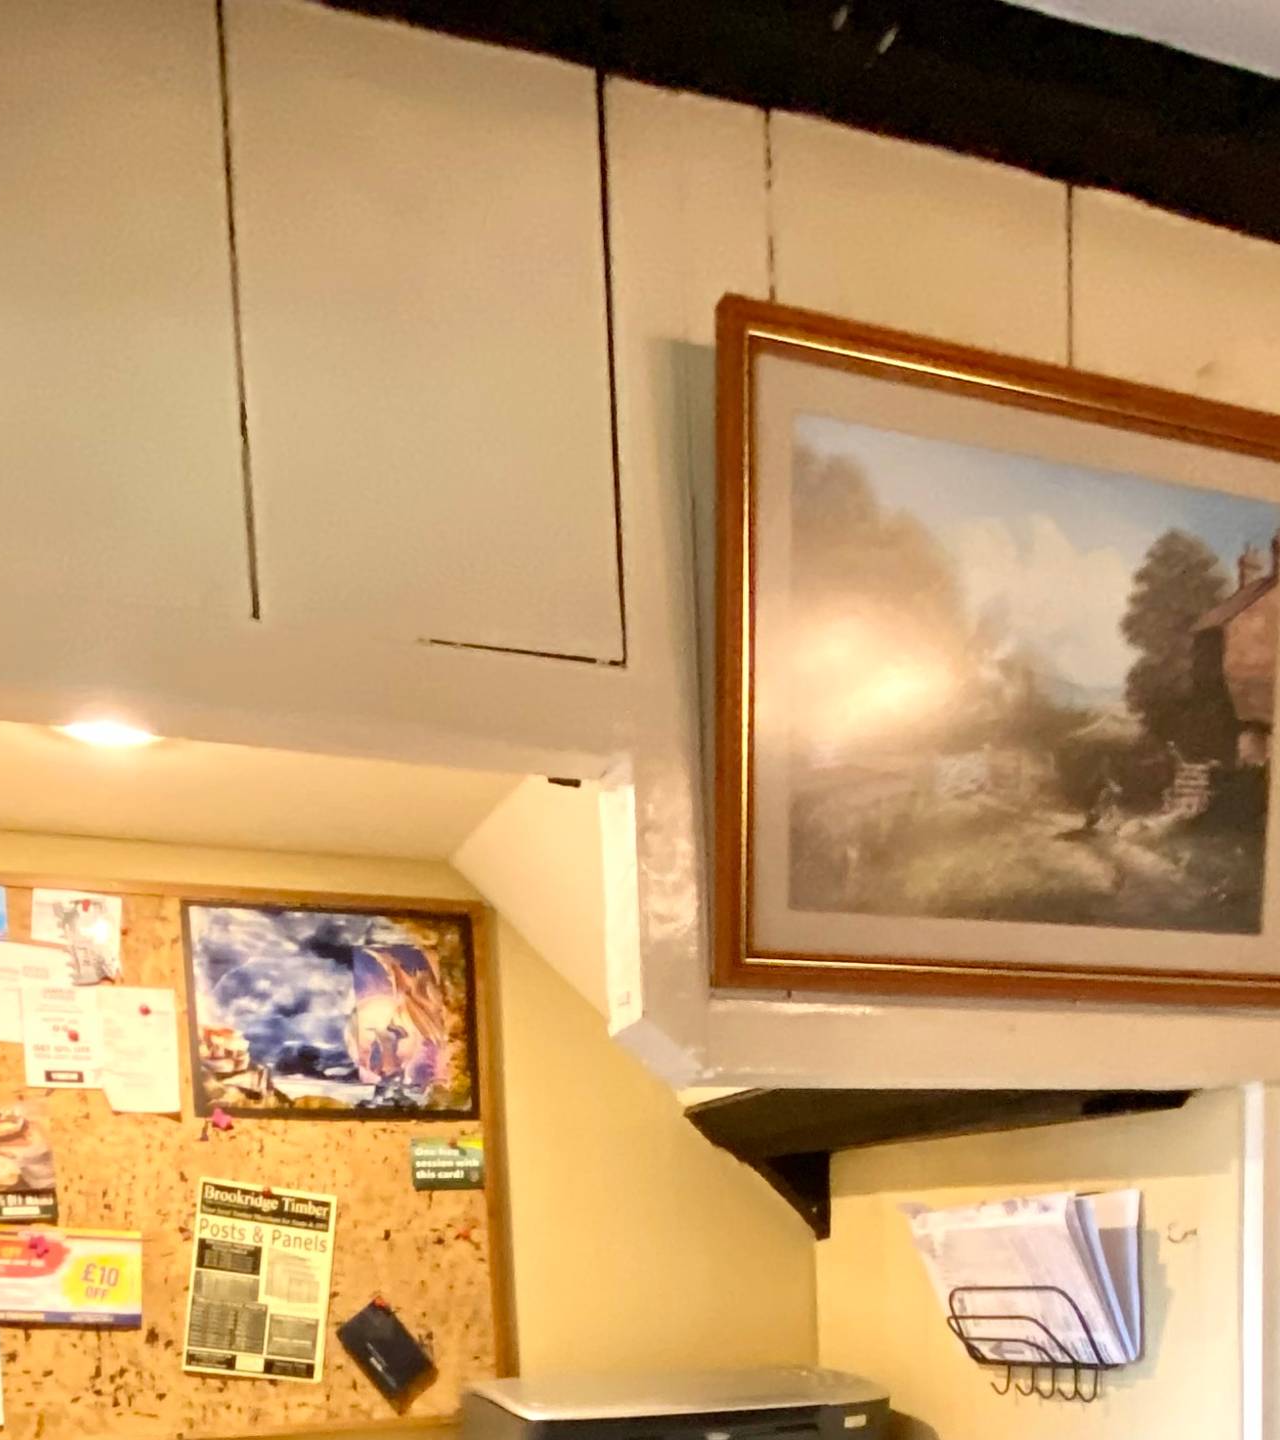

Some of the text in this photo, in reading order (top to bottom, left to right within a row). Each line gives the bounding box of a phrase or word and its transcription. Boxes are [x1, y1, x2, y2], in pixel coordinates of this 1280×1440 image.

[415, 1158, 480, 1168] session with
[415, 1169, 465, 1179] this card!
[203, 1184, 279, 1213] Brookridge
[282, 1196, 330, 1218] Timber
[199, 1217, 328, 1254] Posts & Panels
[80, 1263, 120, 1287] £10
[84, 1286, 108, 1301] OFF
